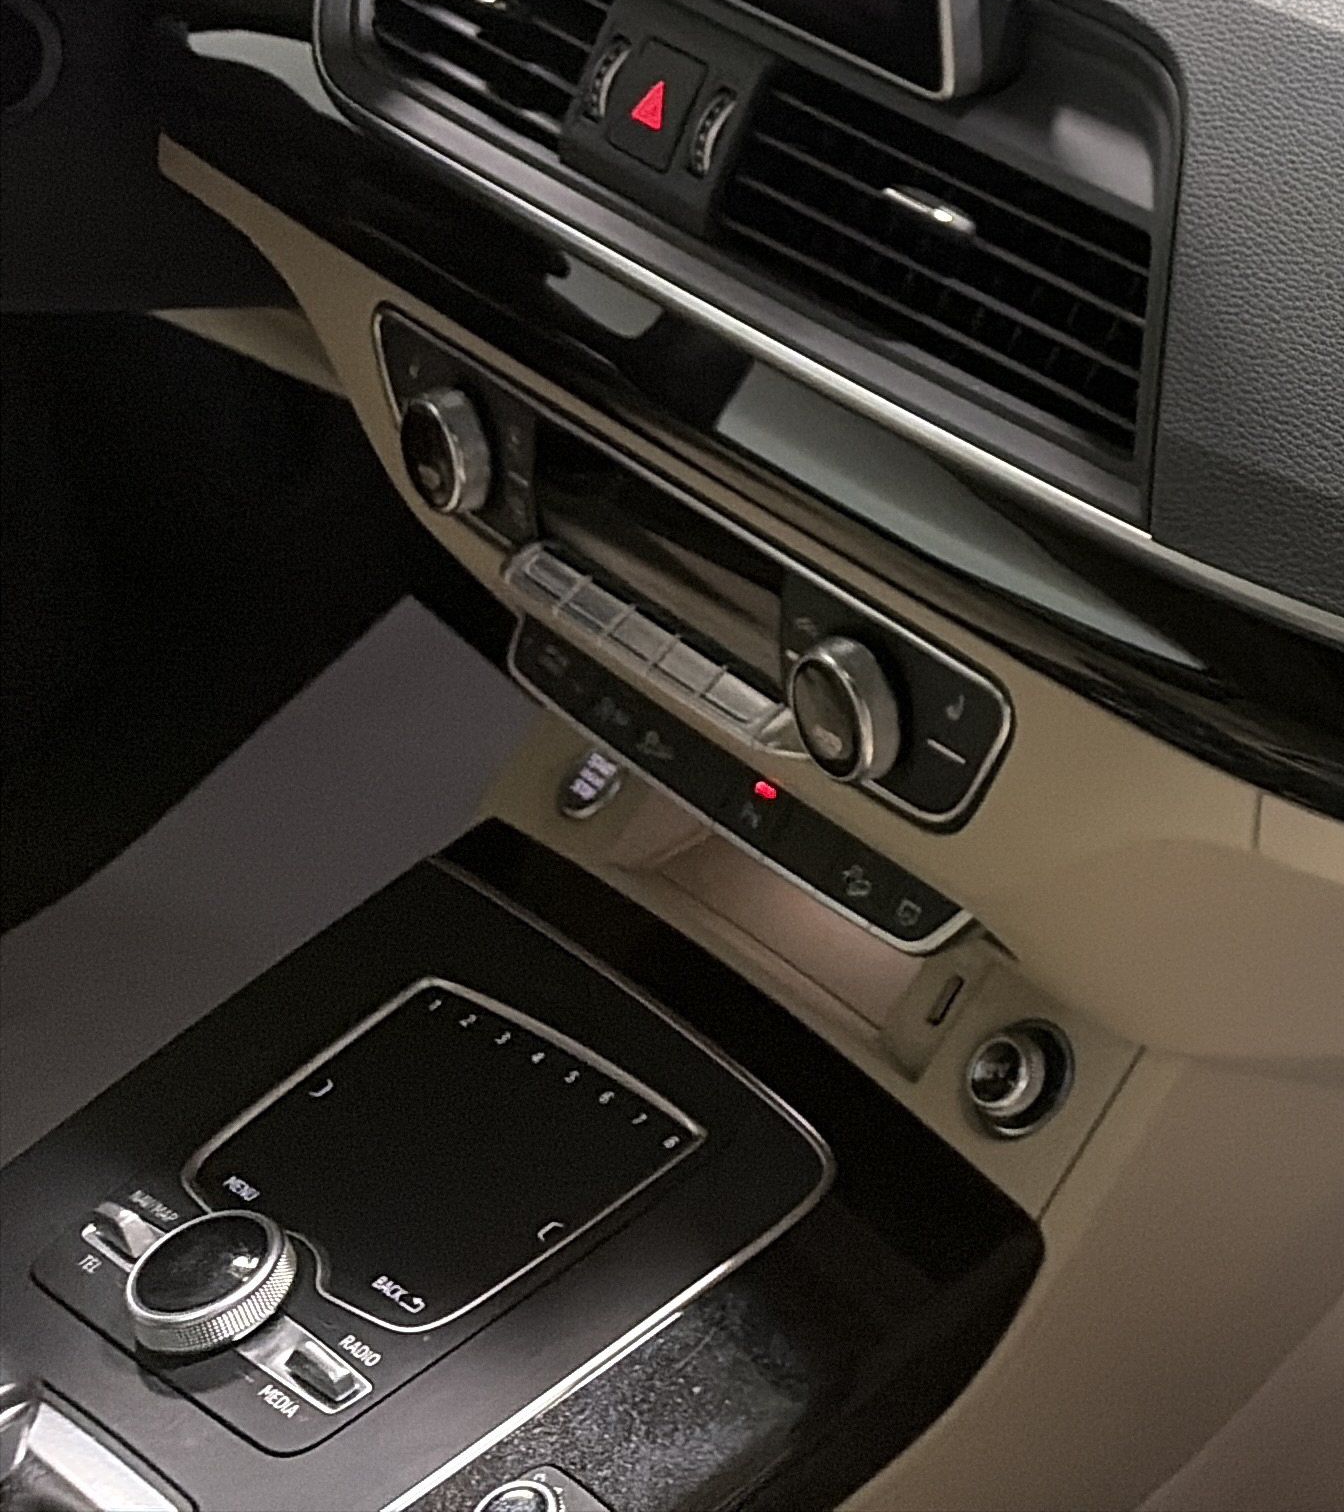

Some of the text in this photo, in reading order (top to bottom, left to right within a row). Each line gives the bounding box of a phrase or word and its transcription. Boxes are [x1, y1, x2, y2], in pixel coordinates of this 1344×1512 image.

[459, 1014, 477, 1027] 2
[494, 1031, 511, 1044] 3
[531, 1052, 545, 1064] 4
[564, 1070, 580, 1083] 5
[599, 1091, 615, 1104] 6
[222, 1175, 260, 1201] MENU
[77, 1254, 102, 1273] TEL
[371, 1275, 408, 1303] BACK
[338, 1334, 382, 1367] RADIO
[257, 1384, 300, 1419] MEDIA
